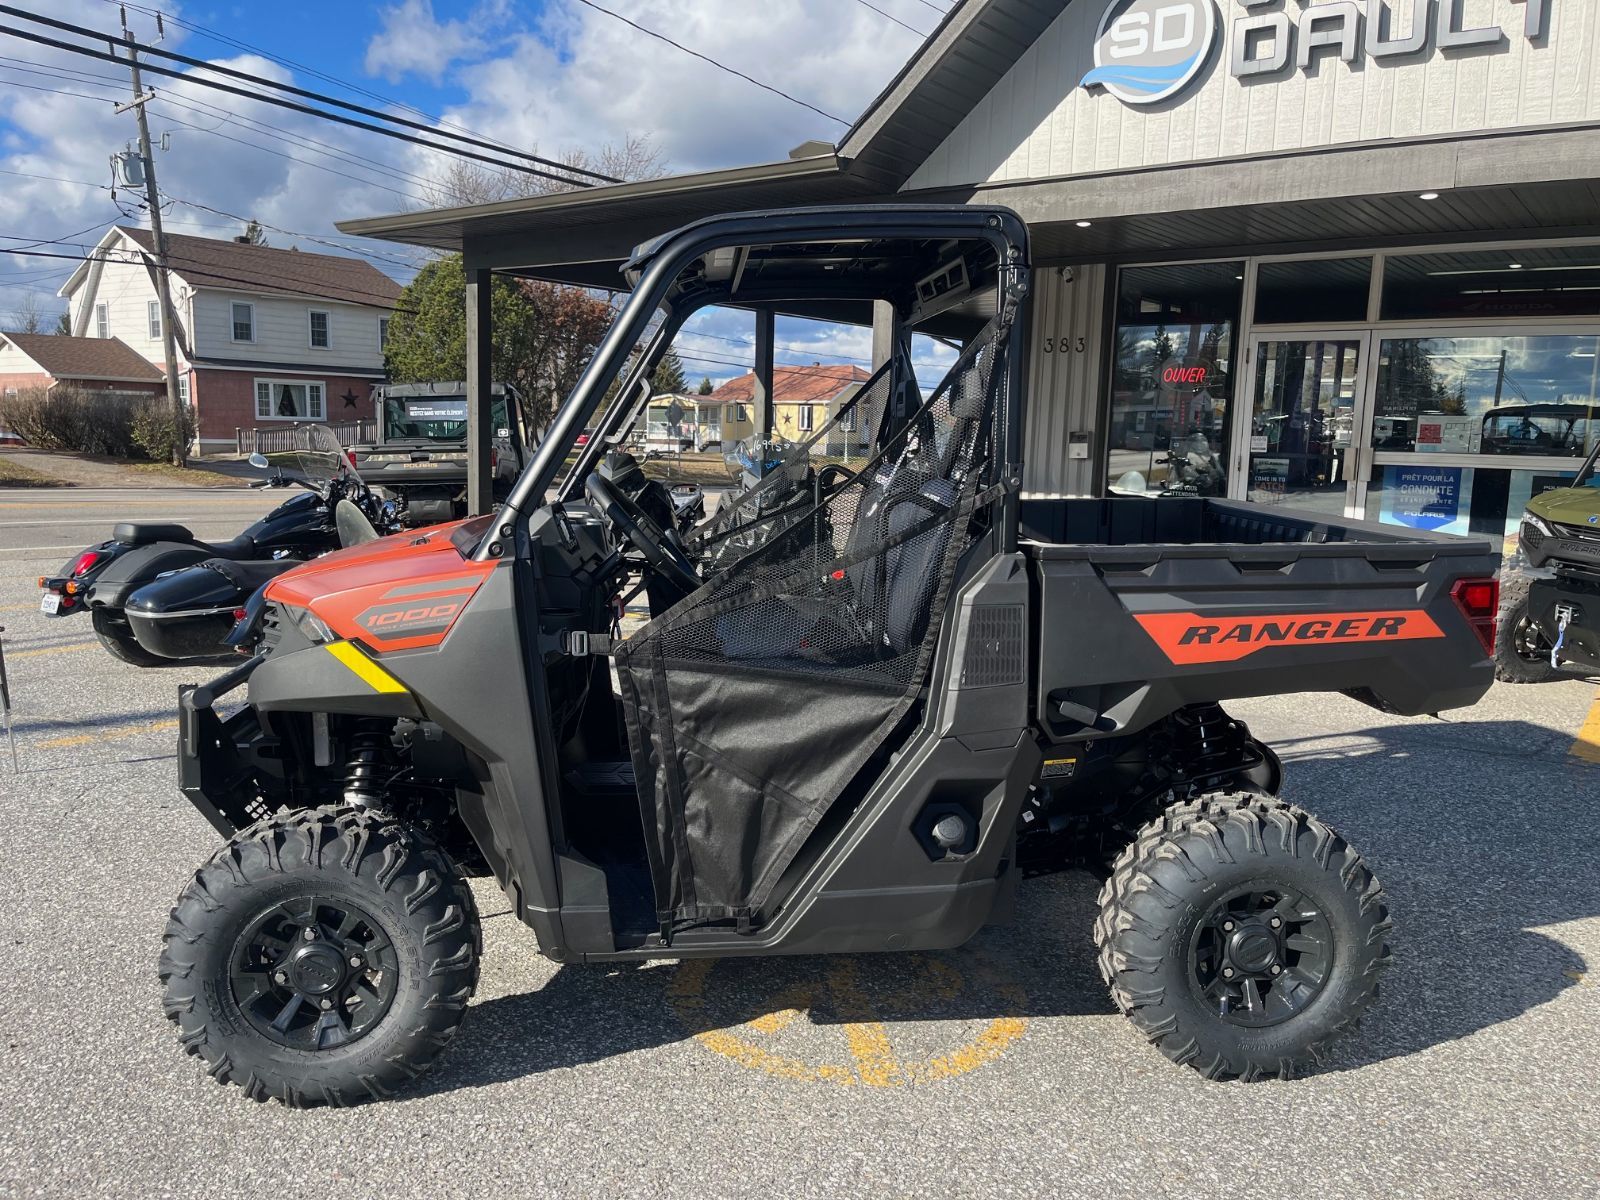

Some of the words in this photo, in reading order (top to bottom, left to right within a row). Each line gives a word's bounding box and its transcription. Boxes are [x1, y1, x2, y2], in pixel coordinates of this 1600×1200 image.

[1110, 3, 1194, 58] SD
[1044, 337, 1086, 353] 383
[1401, 473, 1421, 481] PRÊT
[1422, 474, 1442, 482] POUR
[1443, 475, 1454, 483] LA
[1400, 484, 1454, 496] CONDUITE
[367, 604, 458, 627] 1000
[1177, 616, 1407, 646] RANGER
